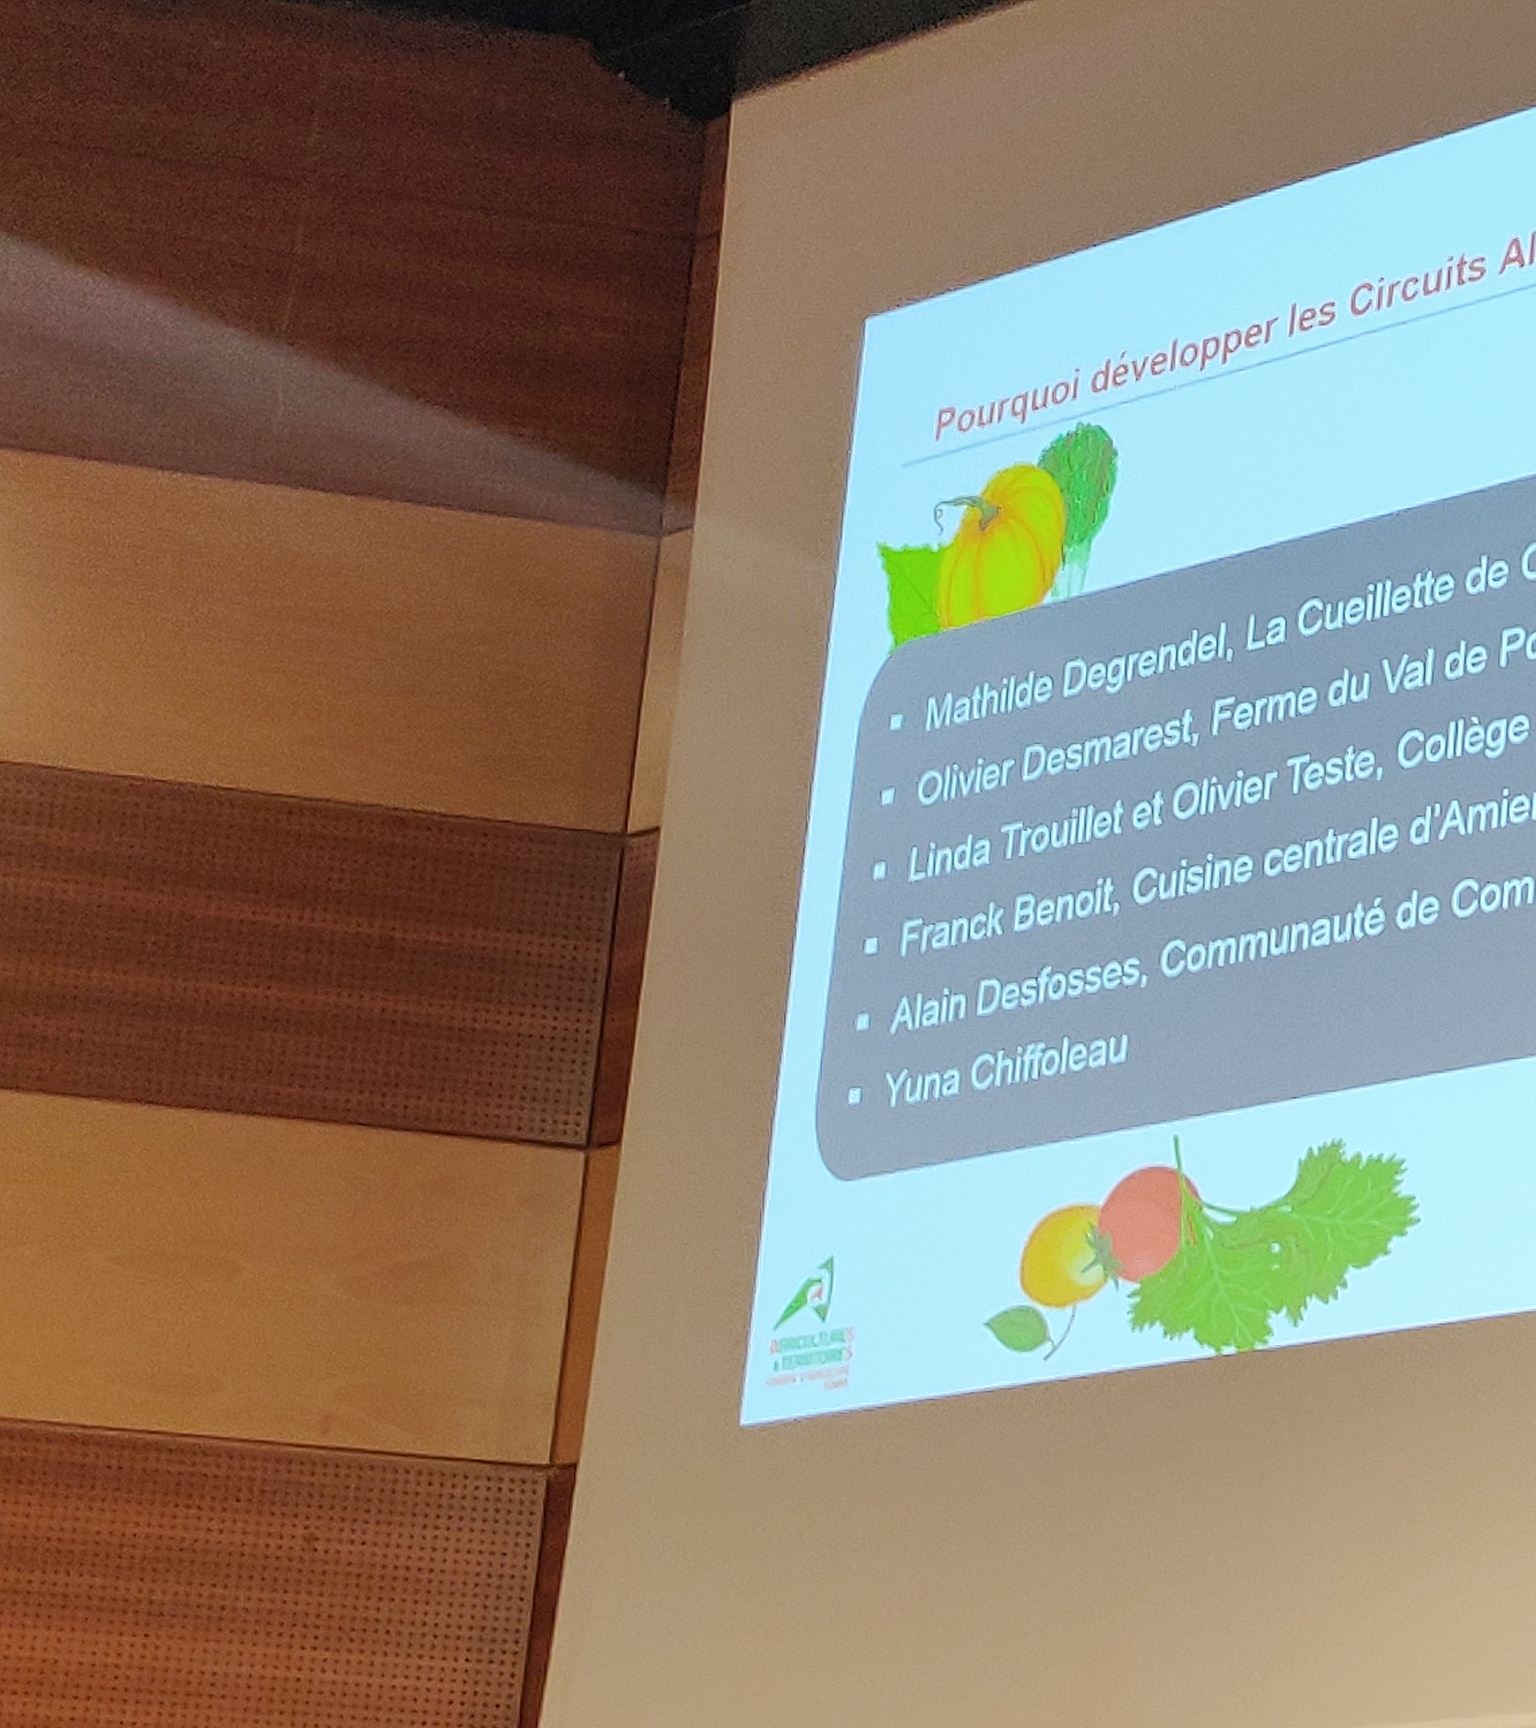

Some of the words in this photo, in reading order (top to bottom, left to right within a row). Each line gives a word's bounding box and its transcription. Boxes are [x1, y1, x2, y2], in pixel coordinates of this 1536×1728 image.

[935, 367, 1081, 440] Pourquoi
[1090, 315, 1279, 394] développer
[1288, 298, 1337, 338] les
[1348, 252, 1488, 317] Circuits
[917, 757, 1015, 806] Olivier
[1021, 708, 1200, 783] Desmarest,
[1211, 685, 1318, 736] Ferme
[1328, 667, 1371, 708] du
[1382, 647, 1436, 694] Val
[1444, 639, 1488, 680] de
[925, 671, 1053, 732] Mathilde
[1062, 622, 1234, 698] Degrendel,
[1246, 613, 1287, 651] La
[1298, 568, 1456, 637] Cueillette
[1465, 554, 1509, 595] de
[908, 834, 992, 883] Linda
[1000, 799, 1124, 860] Trouillet
[1131, 789, 1163, 831] et
[1172, 769, 1278, 820] Olivier
[1287, 745, 1384, 795] Teste,
[1397, 713, 1531, 769] Collège
[889, 987, 967, 1034] Alain
[976, 956, 1149, 1017] Desfosses,
[1160, 896, 1386, 978] Communauté
[1395, 888, 1440, 931] de
[900, 901, 1004, 957] Franck
[1013, 877, 1120, 933] Benoit,
[1132, 852, 1253, 905] Cuisine
[1263, 816, 1399, 877] centrale
[886, 1067, 960, 1108] Yuna
[970, 1034, 1128, 1091] Chiffoleau
